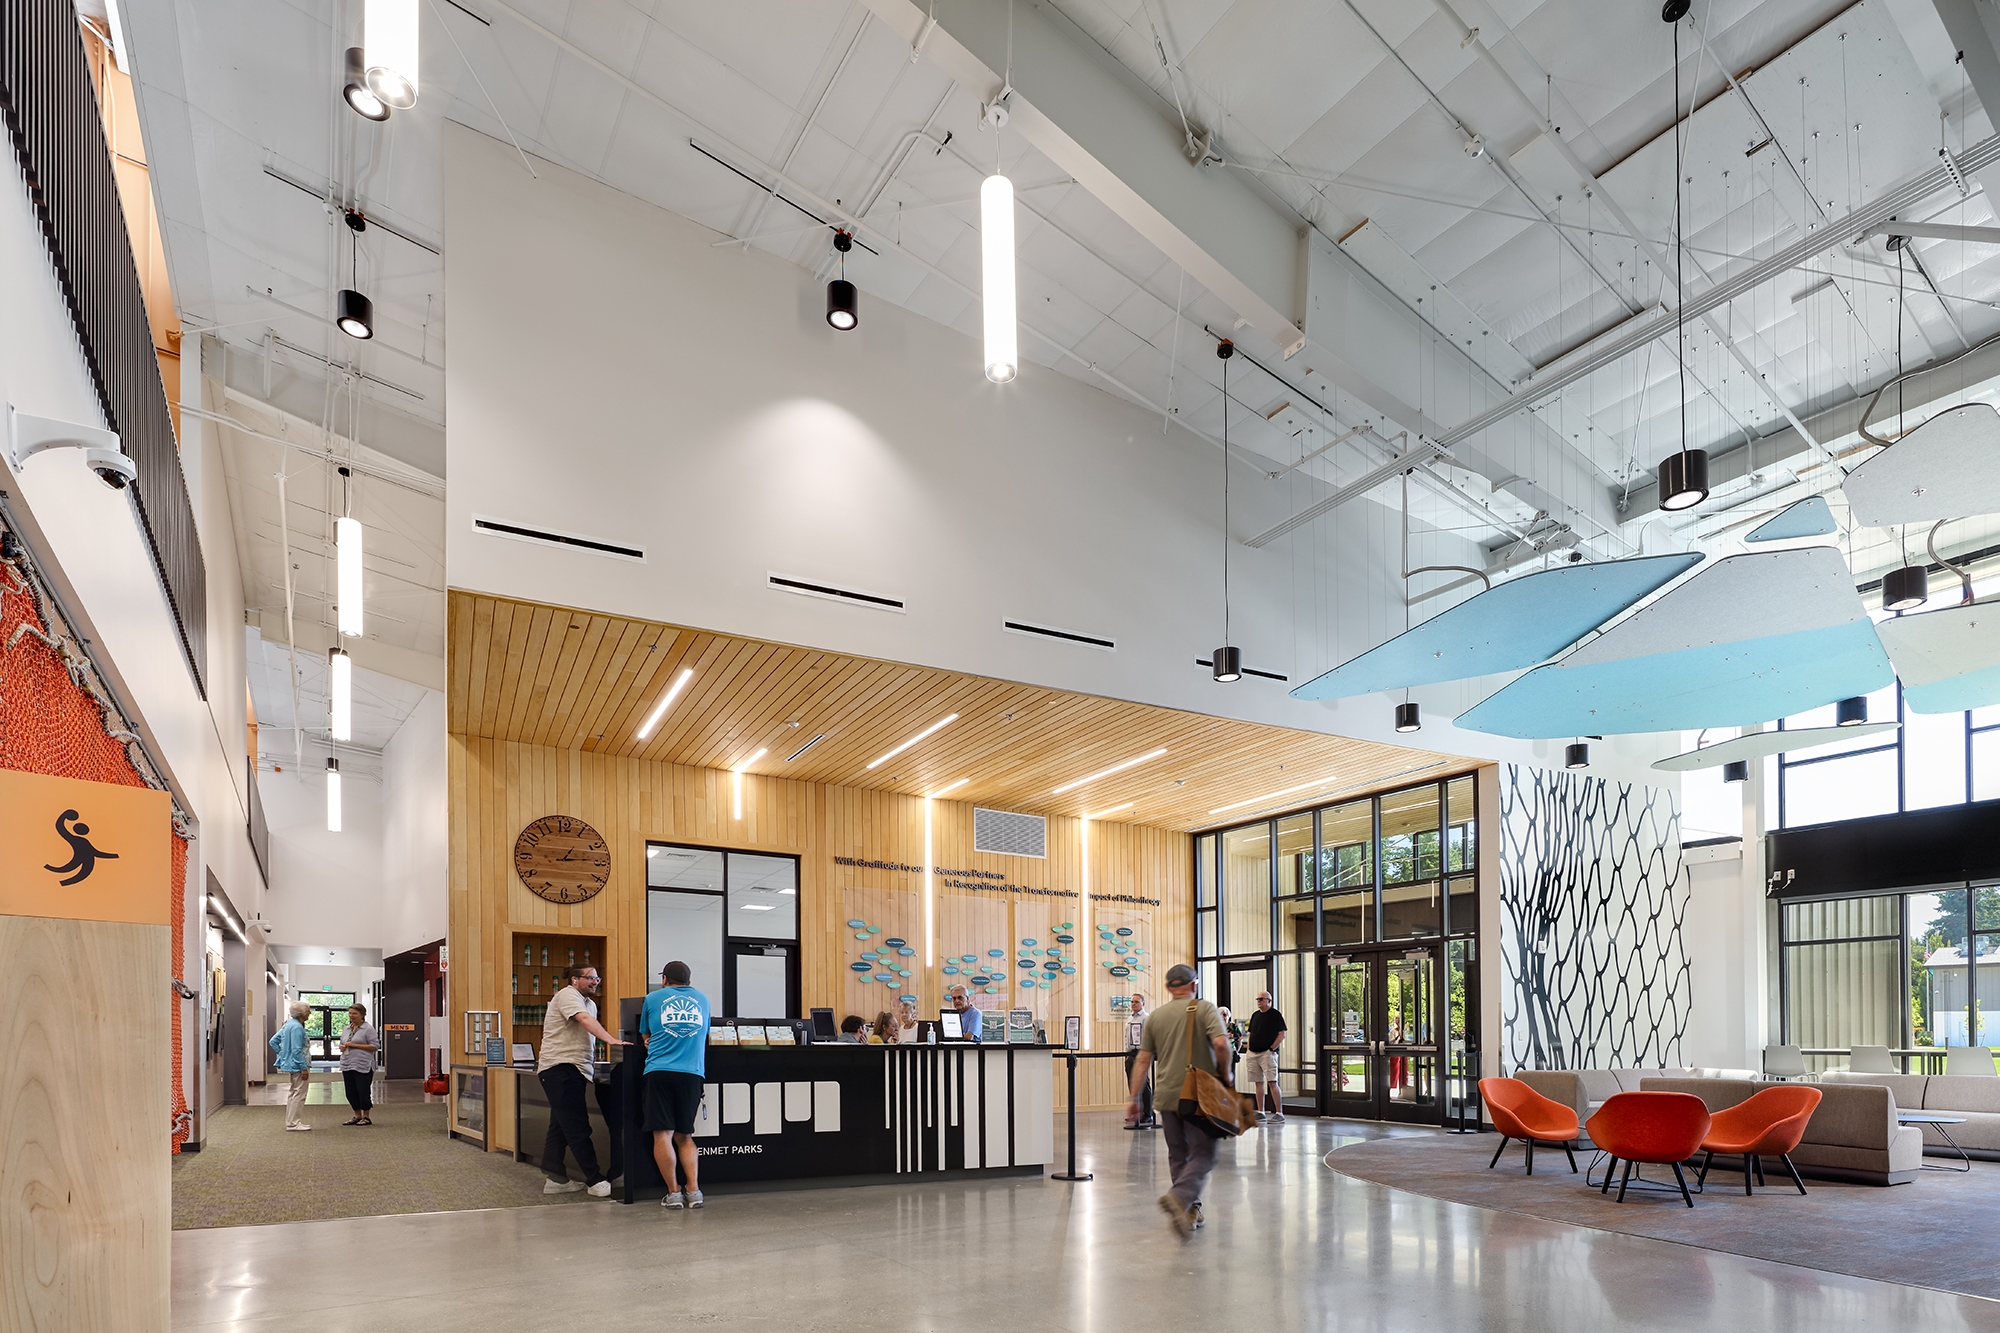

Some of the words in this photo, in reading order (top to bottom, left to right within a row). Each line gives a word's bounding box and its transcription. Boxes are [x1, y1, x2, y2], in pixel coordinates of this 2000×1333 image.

[537, 822, 553, 837] 11
[558, 820, 571, 833] 12
[576, 826, 585, 838] 1
[523, 832, 539, 848] 10
[588, 841, 602, 851] 2
[519, 852, 533, 860] 9
[594, 859, 606, 867] 3
[835, 856, 856, 866] With
[858, 858, 899, 870] Gratitude
[901, 863, 910, 871] to
[912, 865, 925, 873] our
[934, 866, 971, 877] Generous
[972, 869, 1006, 880] Partners
[524, 869, 537, 878] 8
[591, 873, 602, 883] 4
[540, 882, 553, 893] 7
[577, 884, 587, 896] 5
[945, 879, 952, 887] In
[954, 879, 999, 891] Recognition
[1000, 884, 1009, 892] of
[1010, 884, 1022, 894] the
[1024, 885, 1079, 898] Transformative
[1088, 892, 1111, 902] Impact
[1112, 894, 1119, 902] of
[1120, 895, 1161, 907] Philanthropy
[560, 887, 568, 900] 6
[666, 1013, 699, 1022] STAFF
[697, 1146, 729, 1155] ENMET
[731, 1144, 763, 1154] PARKS
